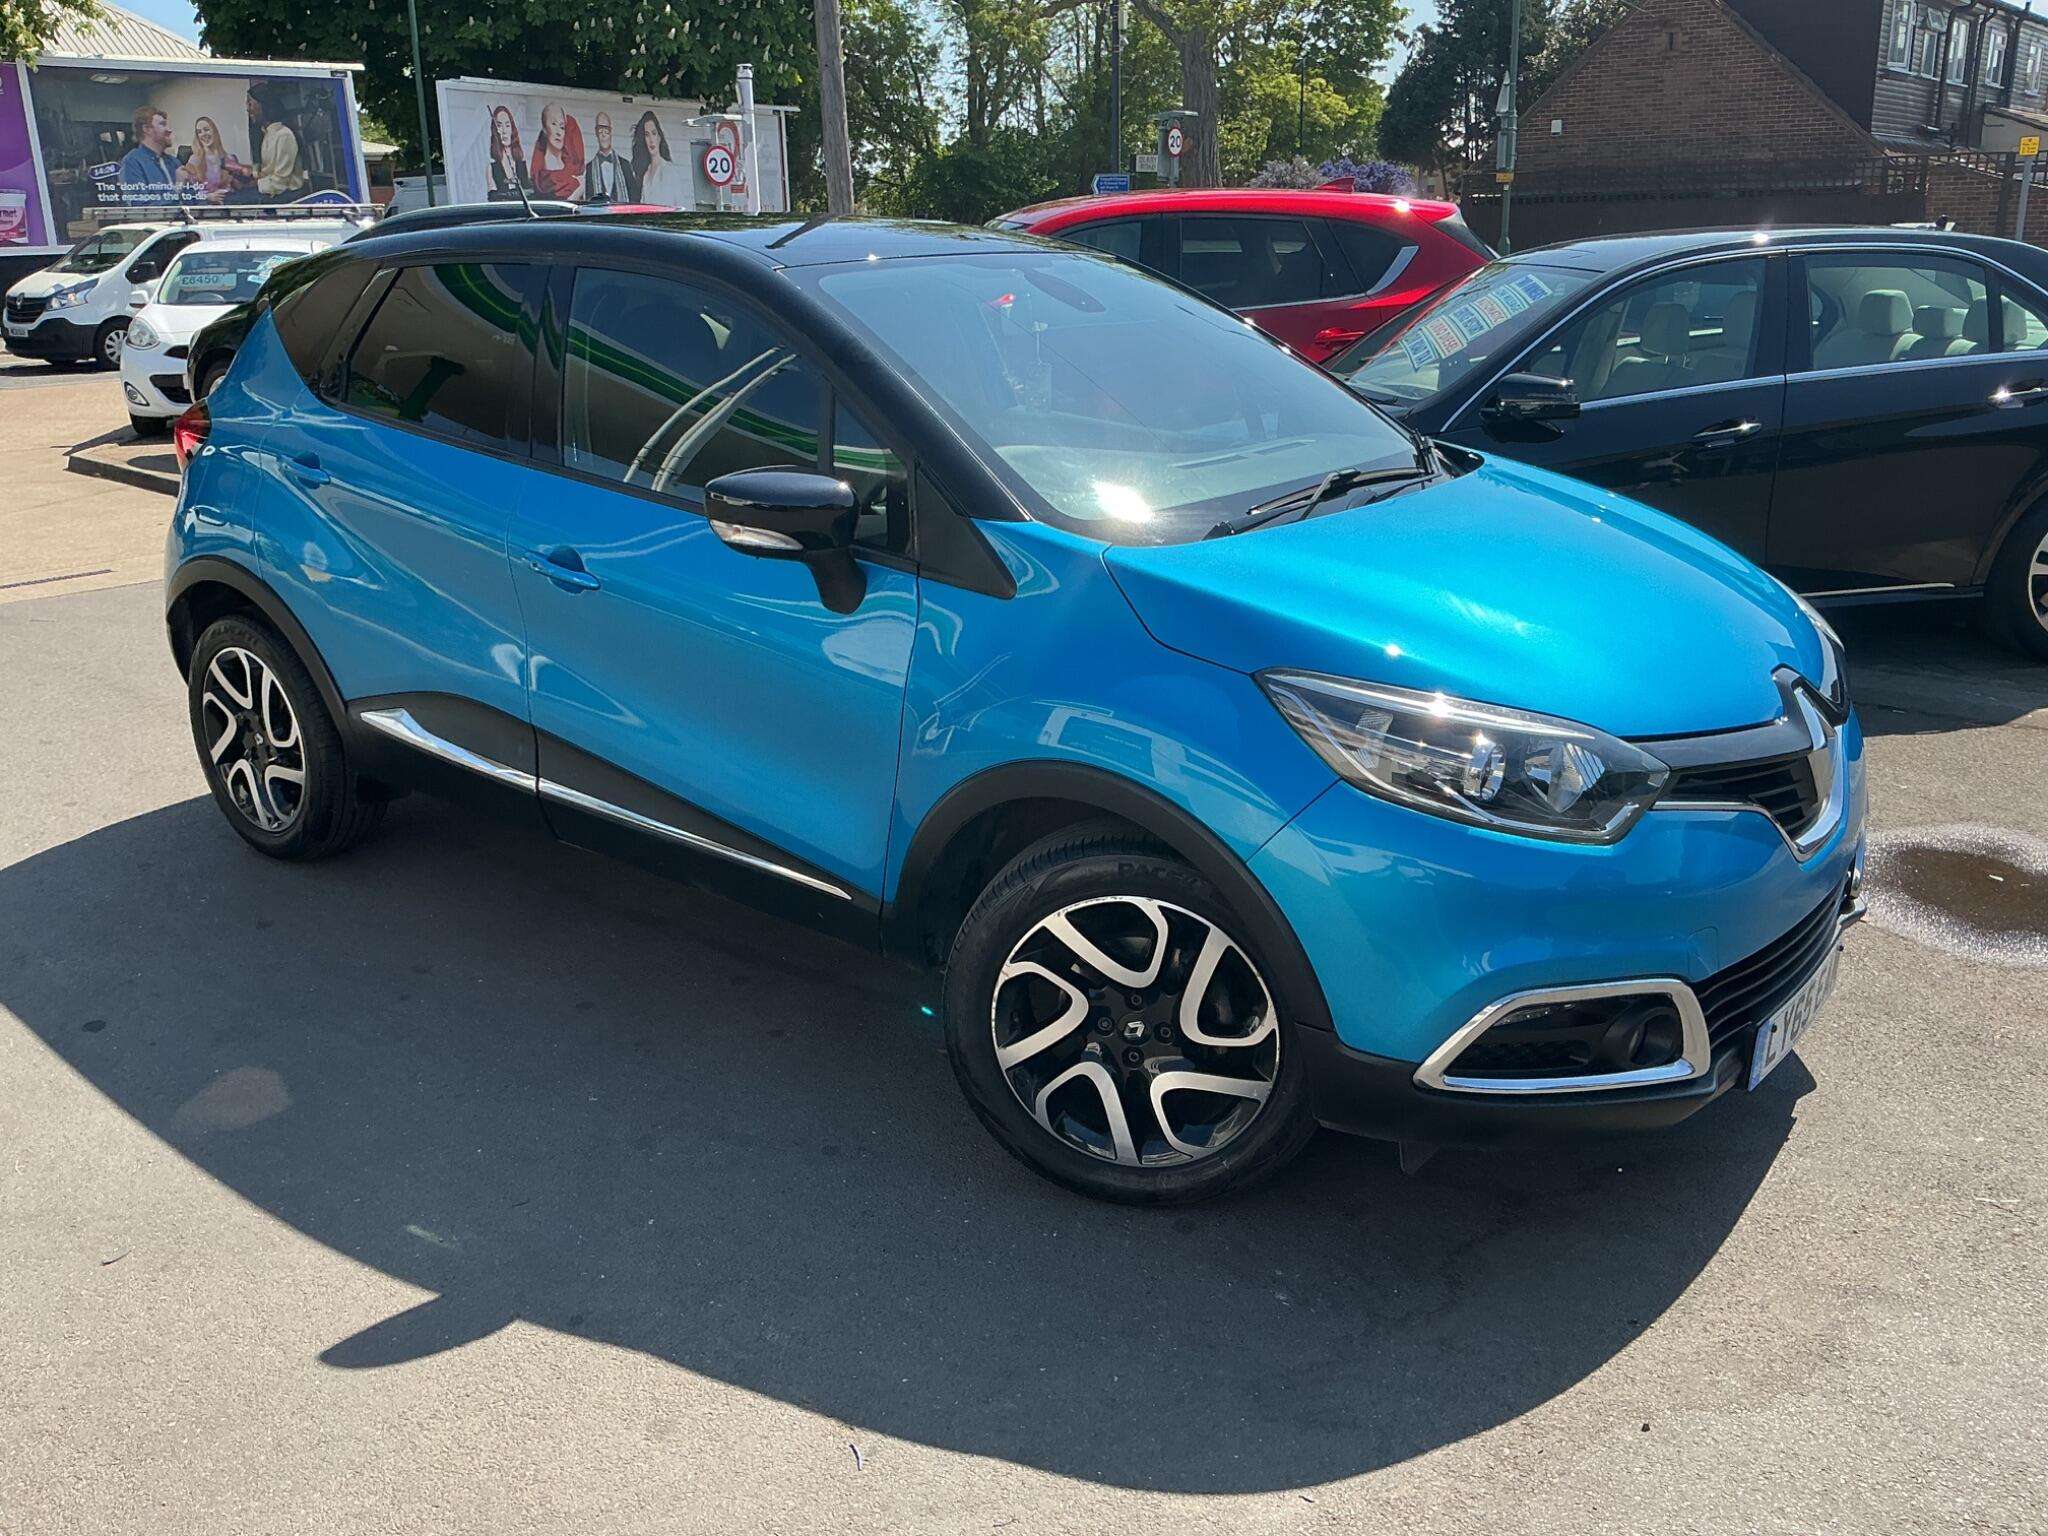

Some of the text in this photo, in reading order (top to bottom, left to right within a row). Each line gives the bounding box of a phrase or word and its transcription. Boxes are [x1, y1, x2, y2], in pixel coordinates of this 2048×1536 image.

[1170, 135, 1181, 147] 20
[709, 157, 730, 174] 20
[96, 183, 115, 191] The
[97, 193, 119, 201] that
[122, 193, 161, 202] escapes
[163, 192, 179, 200] the
